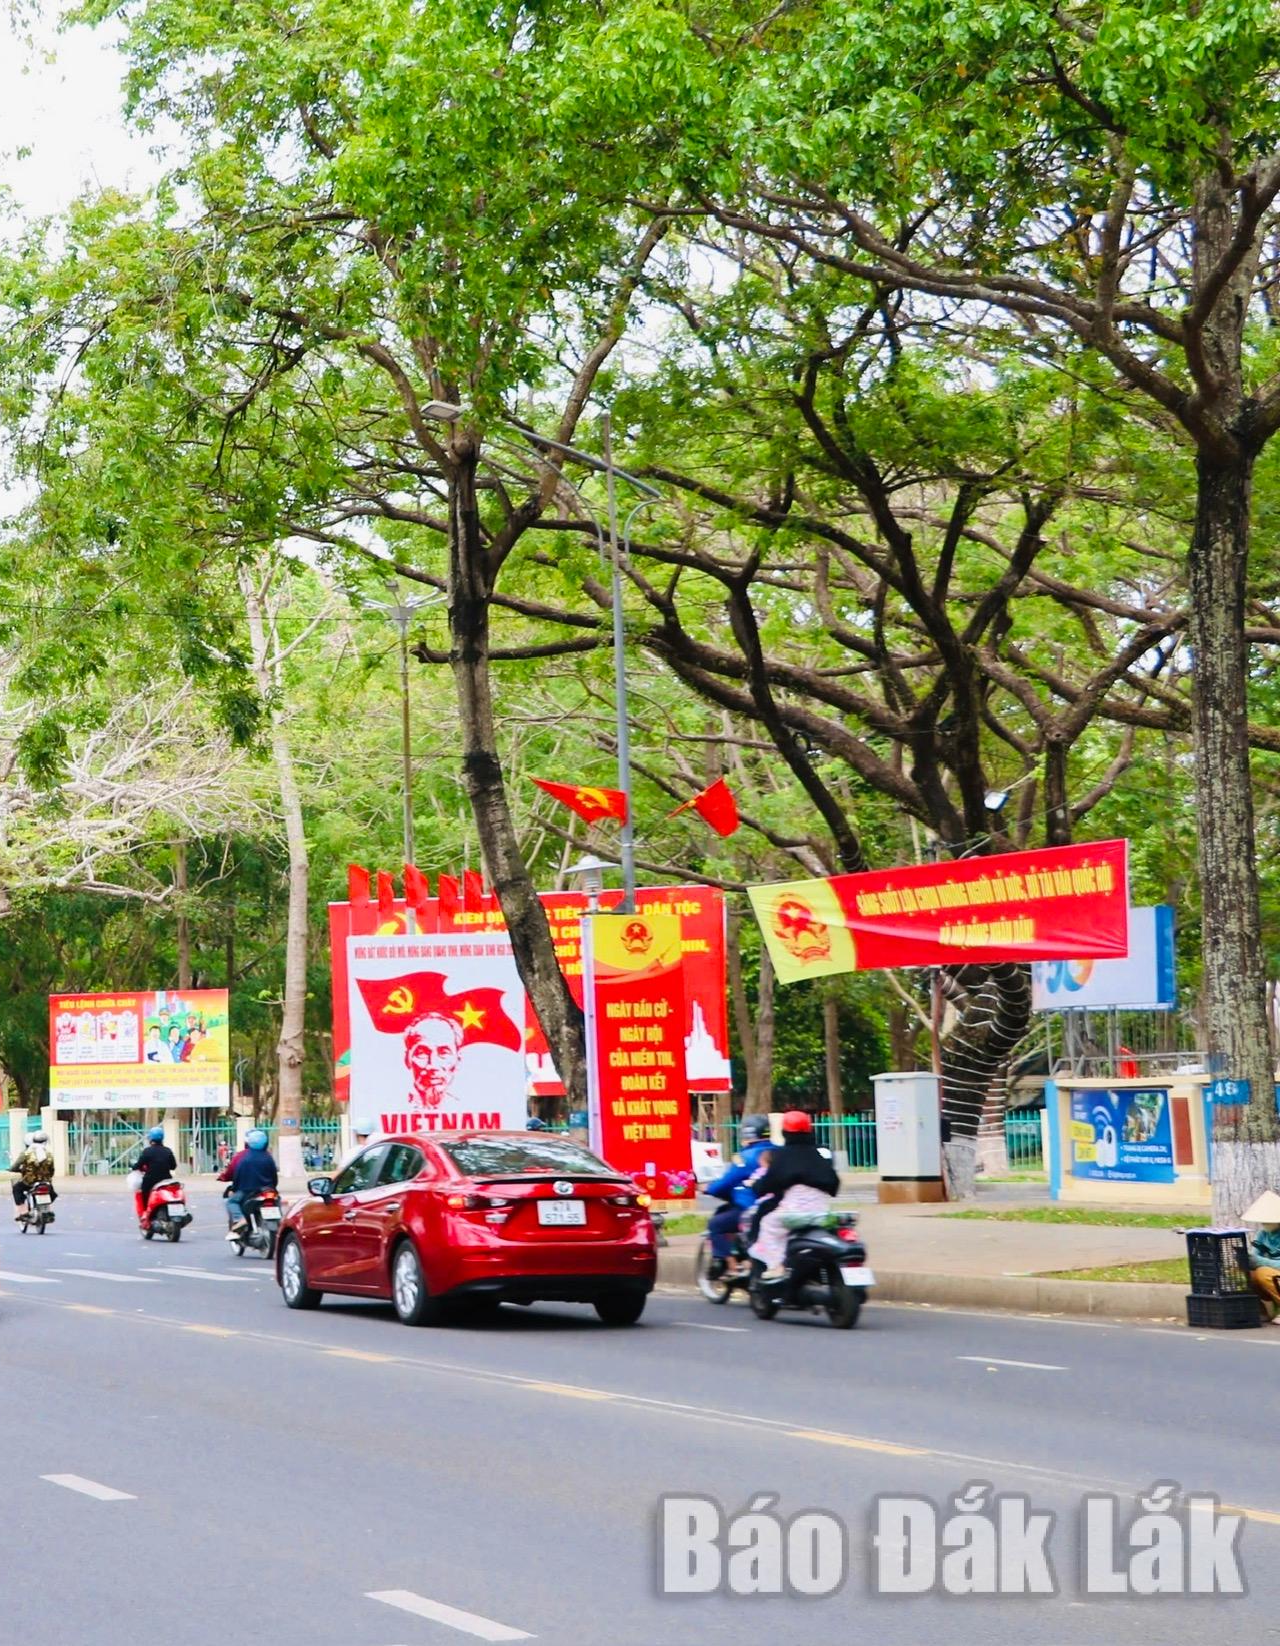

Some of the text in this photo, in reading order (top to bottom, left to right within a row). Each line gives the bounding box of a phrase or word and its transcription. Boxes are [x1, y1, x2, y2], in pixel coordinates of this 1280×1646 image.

[674, 900, 701, 916] TỘC
[606, 1000, 632, 1017] NGÀY
[633, 999, 652, 1017] BẦU
[620, 1024, 663, 1045] NGÀY HỘI
[609, 1047, 630, 1067] CỦA
[630, 1047, 656, 1066] NIỀM
[621, 1071, 666, 1091] ĐOÀN KẾT
[612, 1097, 678, 1118] VÀ KHÁT VỌNG
[623, 1122, 644, 1143] VIỆT
